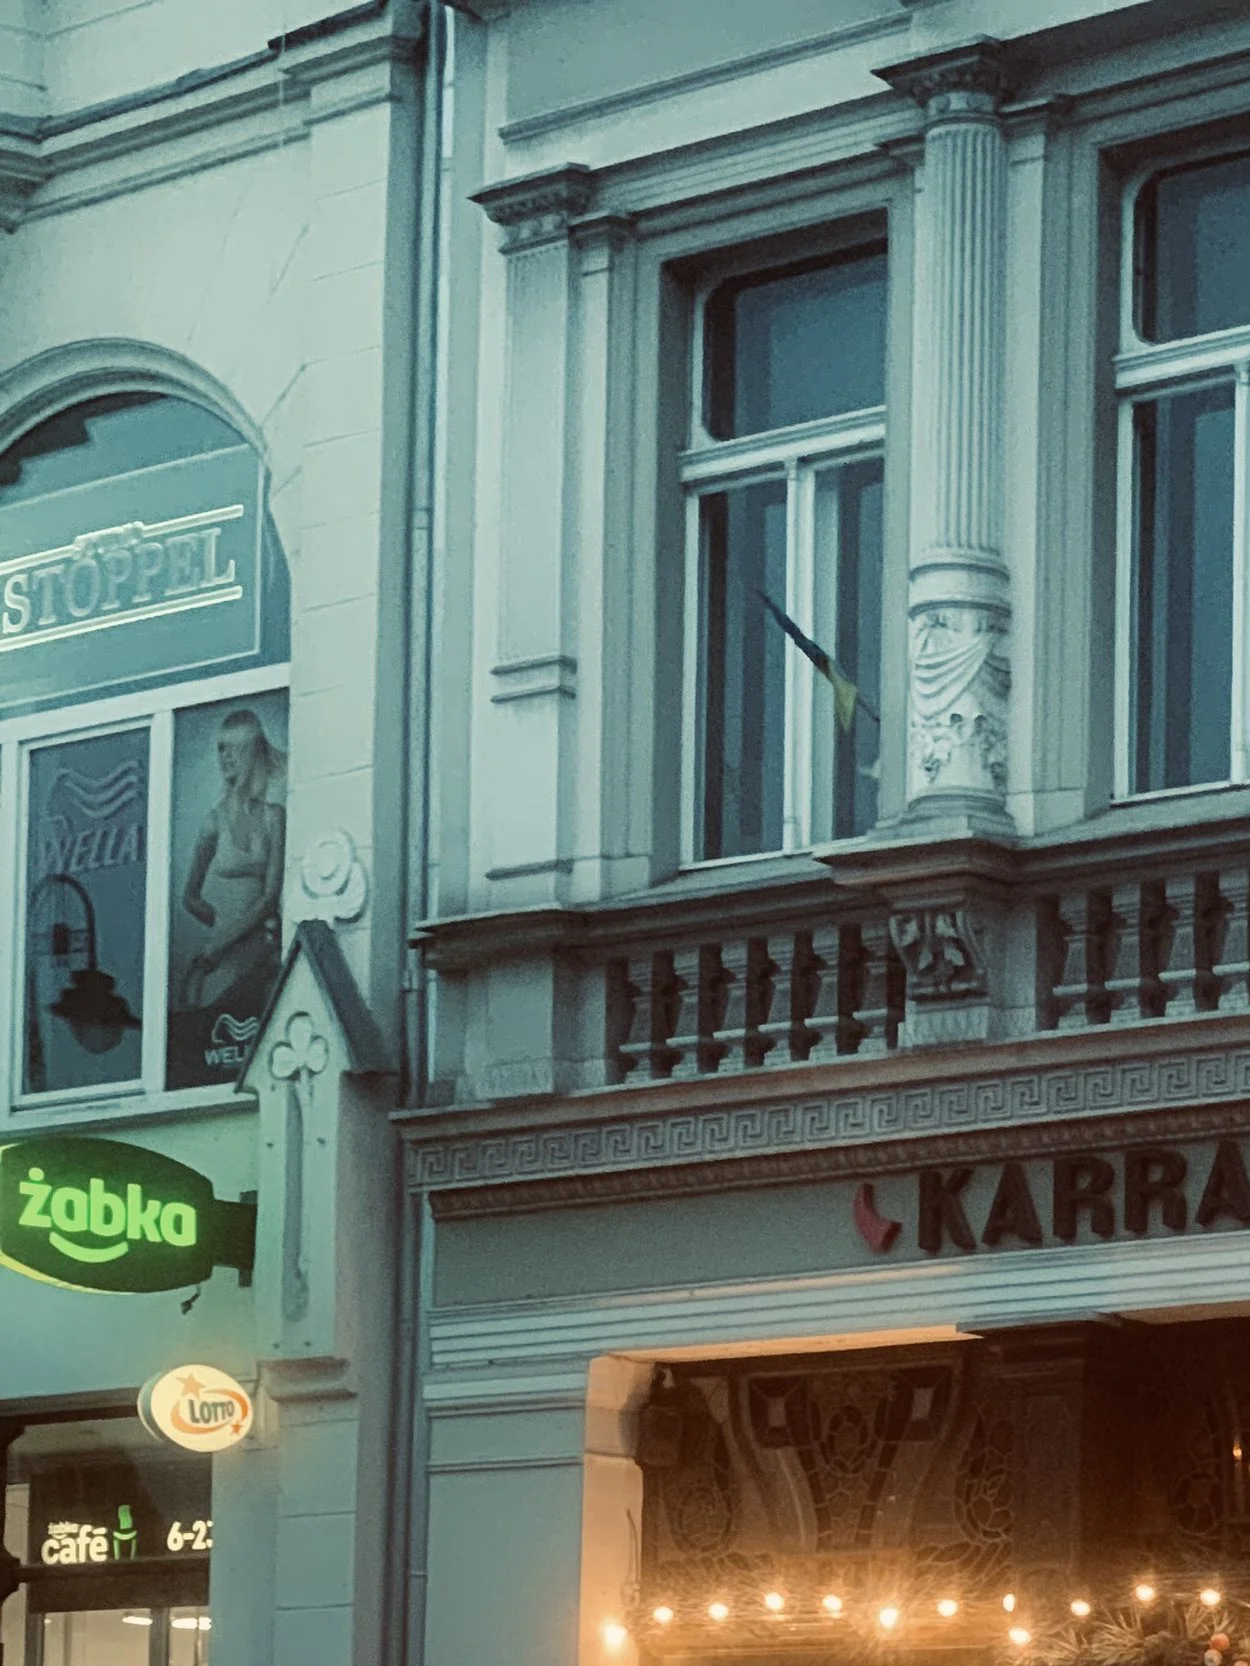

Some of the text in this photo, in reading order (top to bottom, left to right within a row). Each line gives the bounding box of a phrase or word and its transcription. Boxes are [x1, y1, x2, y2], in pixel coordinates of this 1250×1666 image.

[2, 527, 236, 634] STOPPEL
[37, 822, 141, 879] WELLA
[204, 1046, 246, 1067] WEL
[18, 1167, 197, 1247] żabka
[187, 1397, 235, 1426] LOTTO
